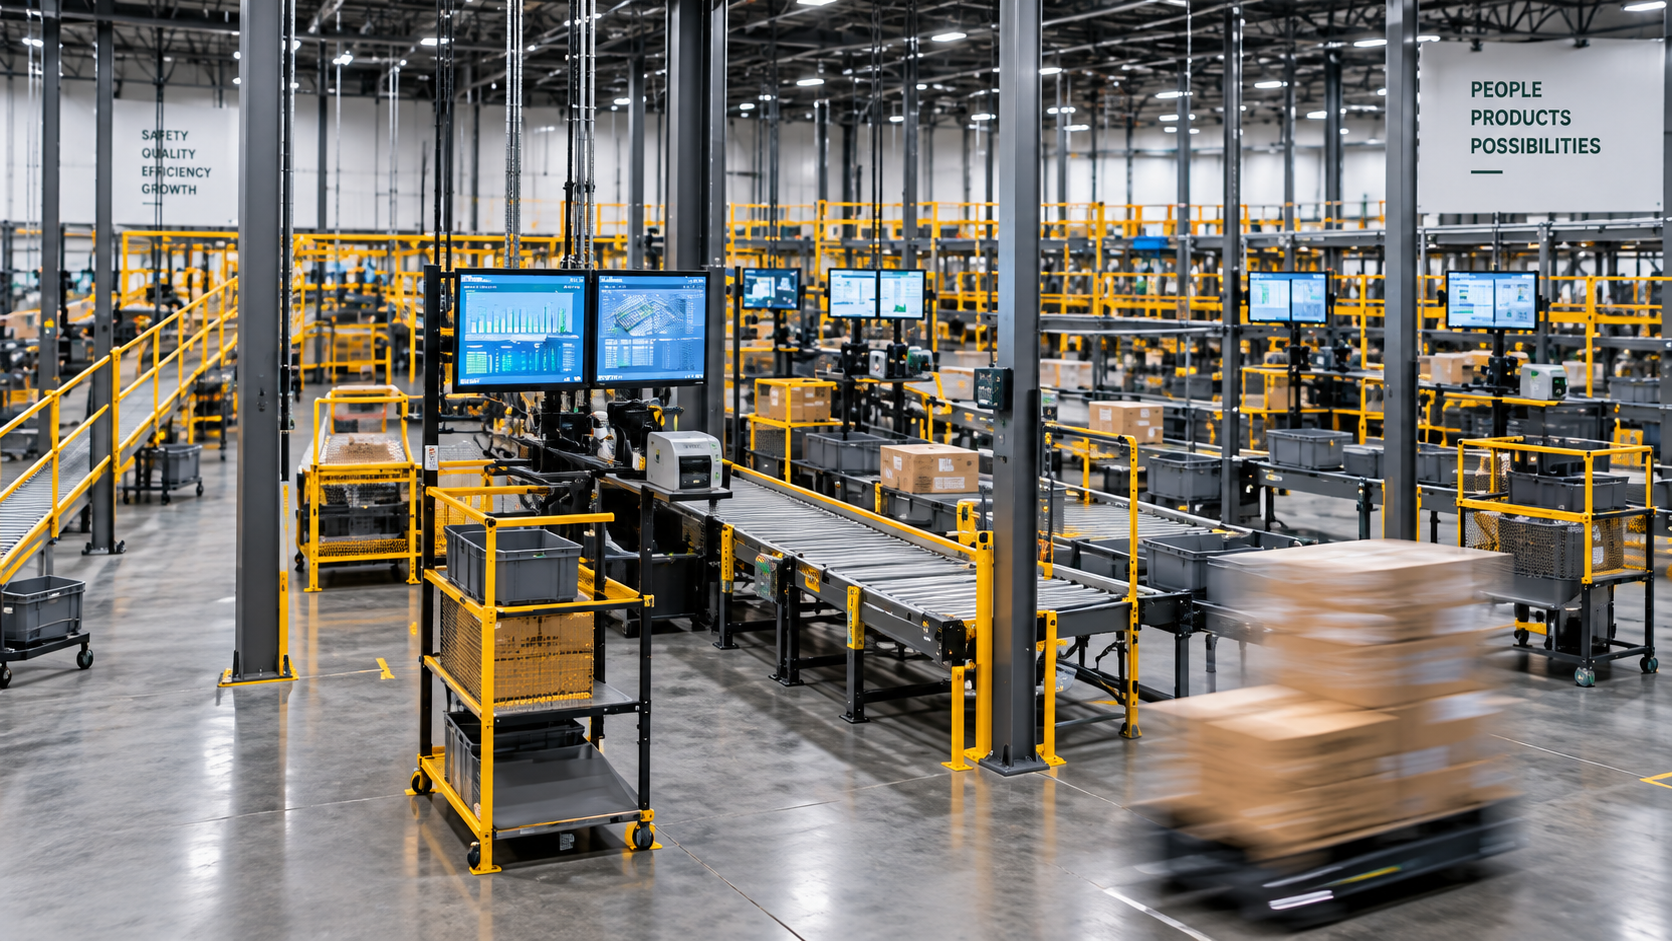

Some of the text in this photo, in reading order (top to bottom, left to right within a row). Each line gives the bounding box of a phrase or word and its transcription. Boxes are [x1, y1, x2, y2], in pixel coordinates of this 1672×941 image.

[1471, 81, 1542, 98] PEOPLE
[1471, 109, 1572, 126] PRODUCTS
[142, 129, 189, 141] SAFETY
[1471, 137, 1602, 154] POSSIBILITIES
[142, 147, 196, 160] QUALITY
[142, 165, 212, 178] EFFICIENCY
[142, 183, 197, 195] GROWTH
